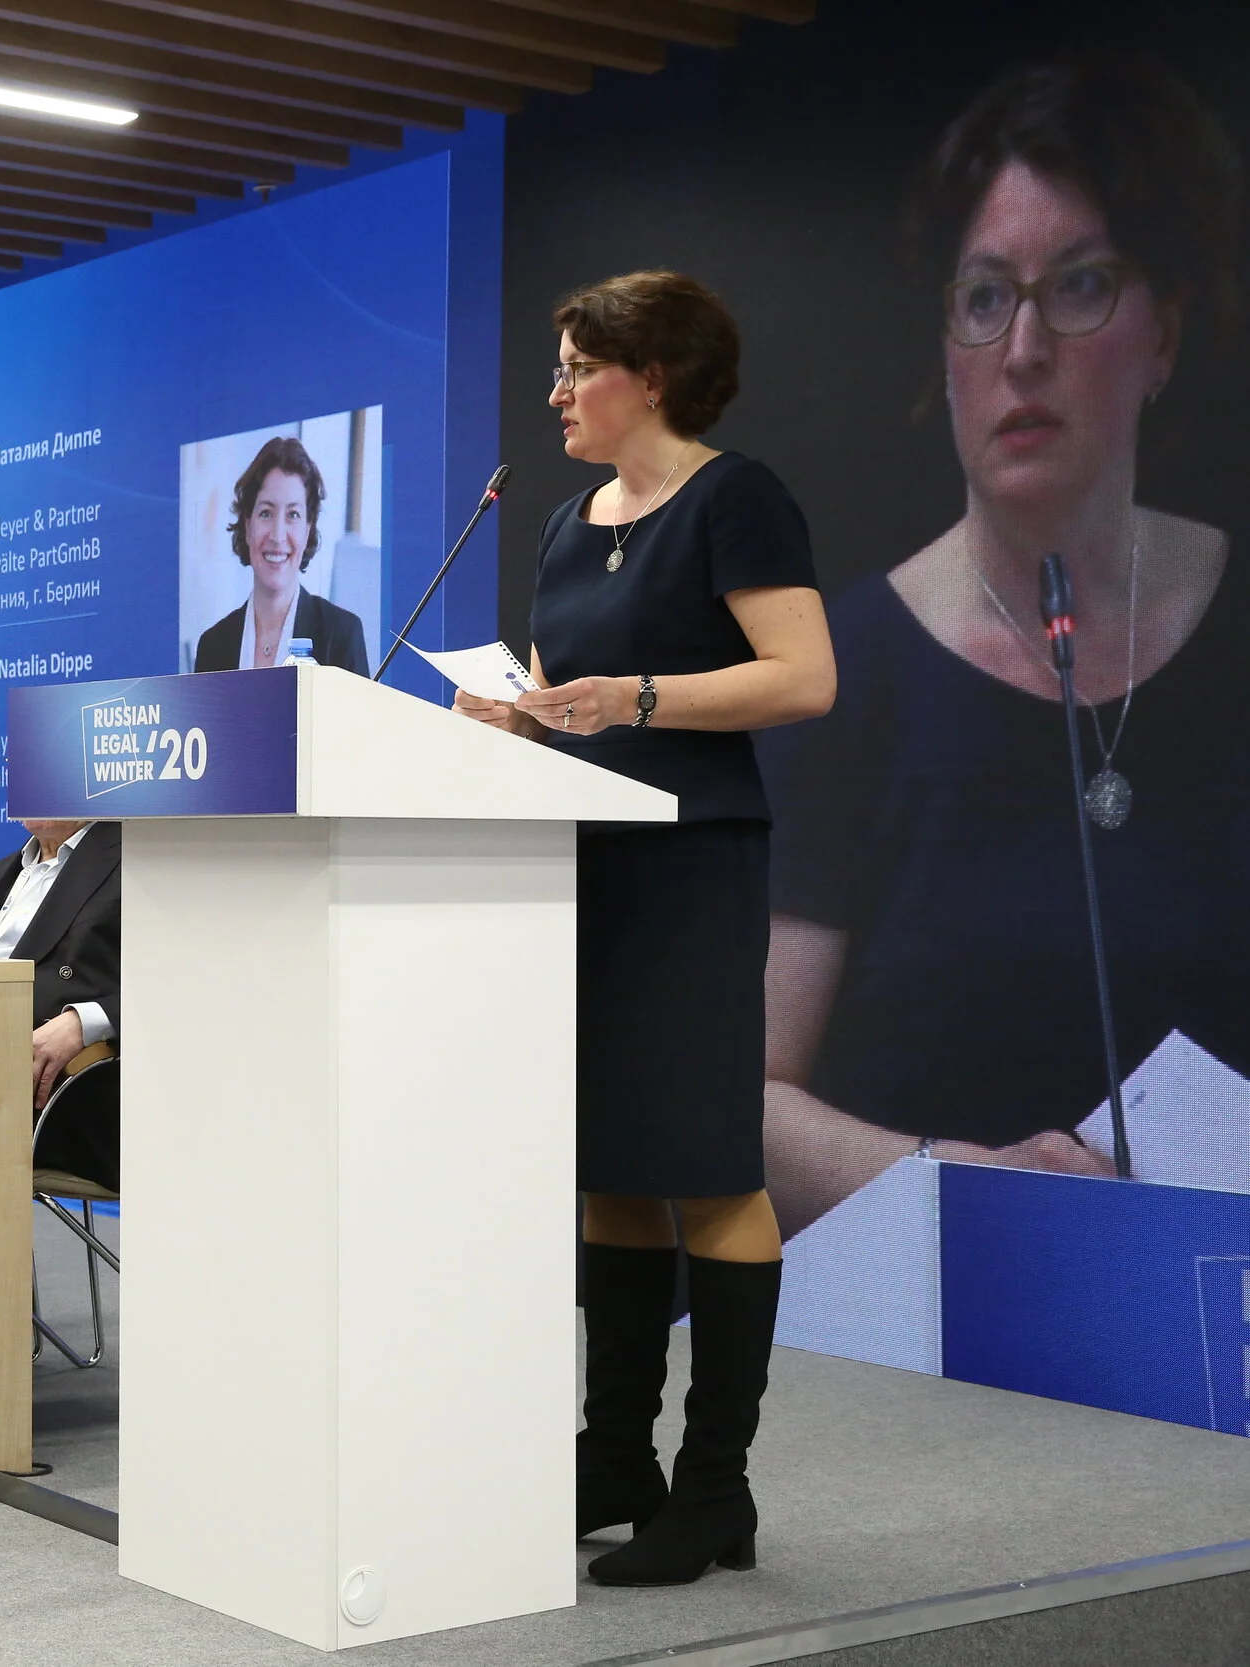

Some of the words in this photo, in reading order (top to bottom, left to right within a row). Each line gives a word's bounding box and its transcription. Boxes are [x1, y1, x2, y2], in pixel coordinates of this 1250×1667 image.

[52, 428, 102, 460] Диппе
[33, 508, 45, 532] &
[49, 503, 101, 529] Partner
[30, 537, 100, 569] PartGmbB
[33, 588, 42, 605] г.
[47, 579, 100, 605] Берлин
[50, 651, 93, 678] Dippe
[93, 704, 161, 728] RUSSIAN
[93, 733, 140, 755] LEGAL
[93, 760, 154, 782] WINTER
